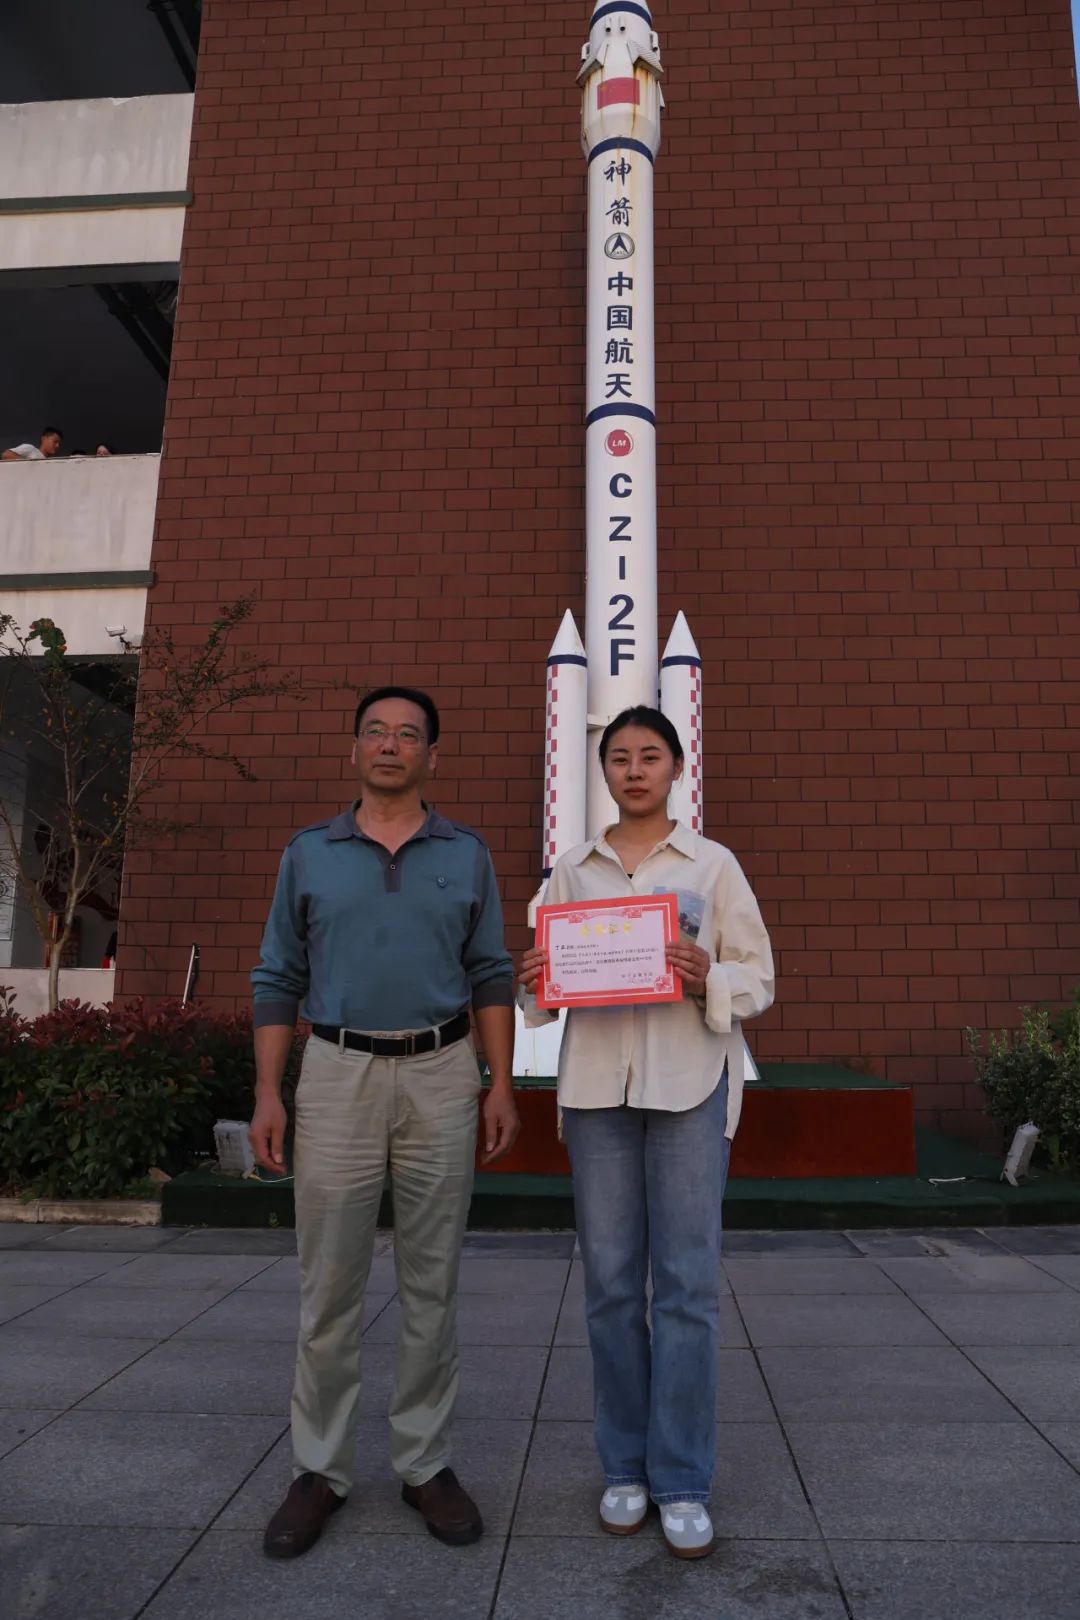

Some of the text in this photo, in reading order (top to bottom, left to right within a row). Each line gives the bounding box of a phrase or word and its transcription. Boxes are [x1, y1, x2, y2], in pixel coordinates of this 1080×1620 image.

[604, 157, 632, 227] 神箭
[605, 271, 633, 398] 中国航天
